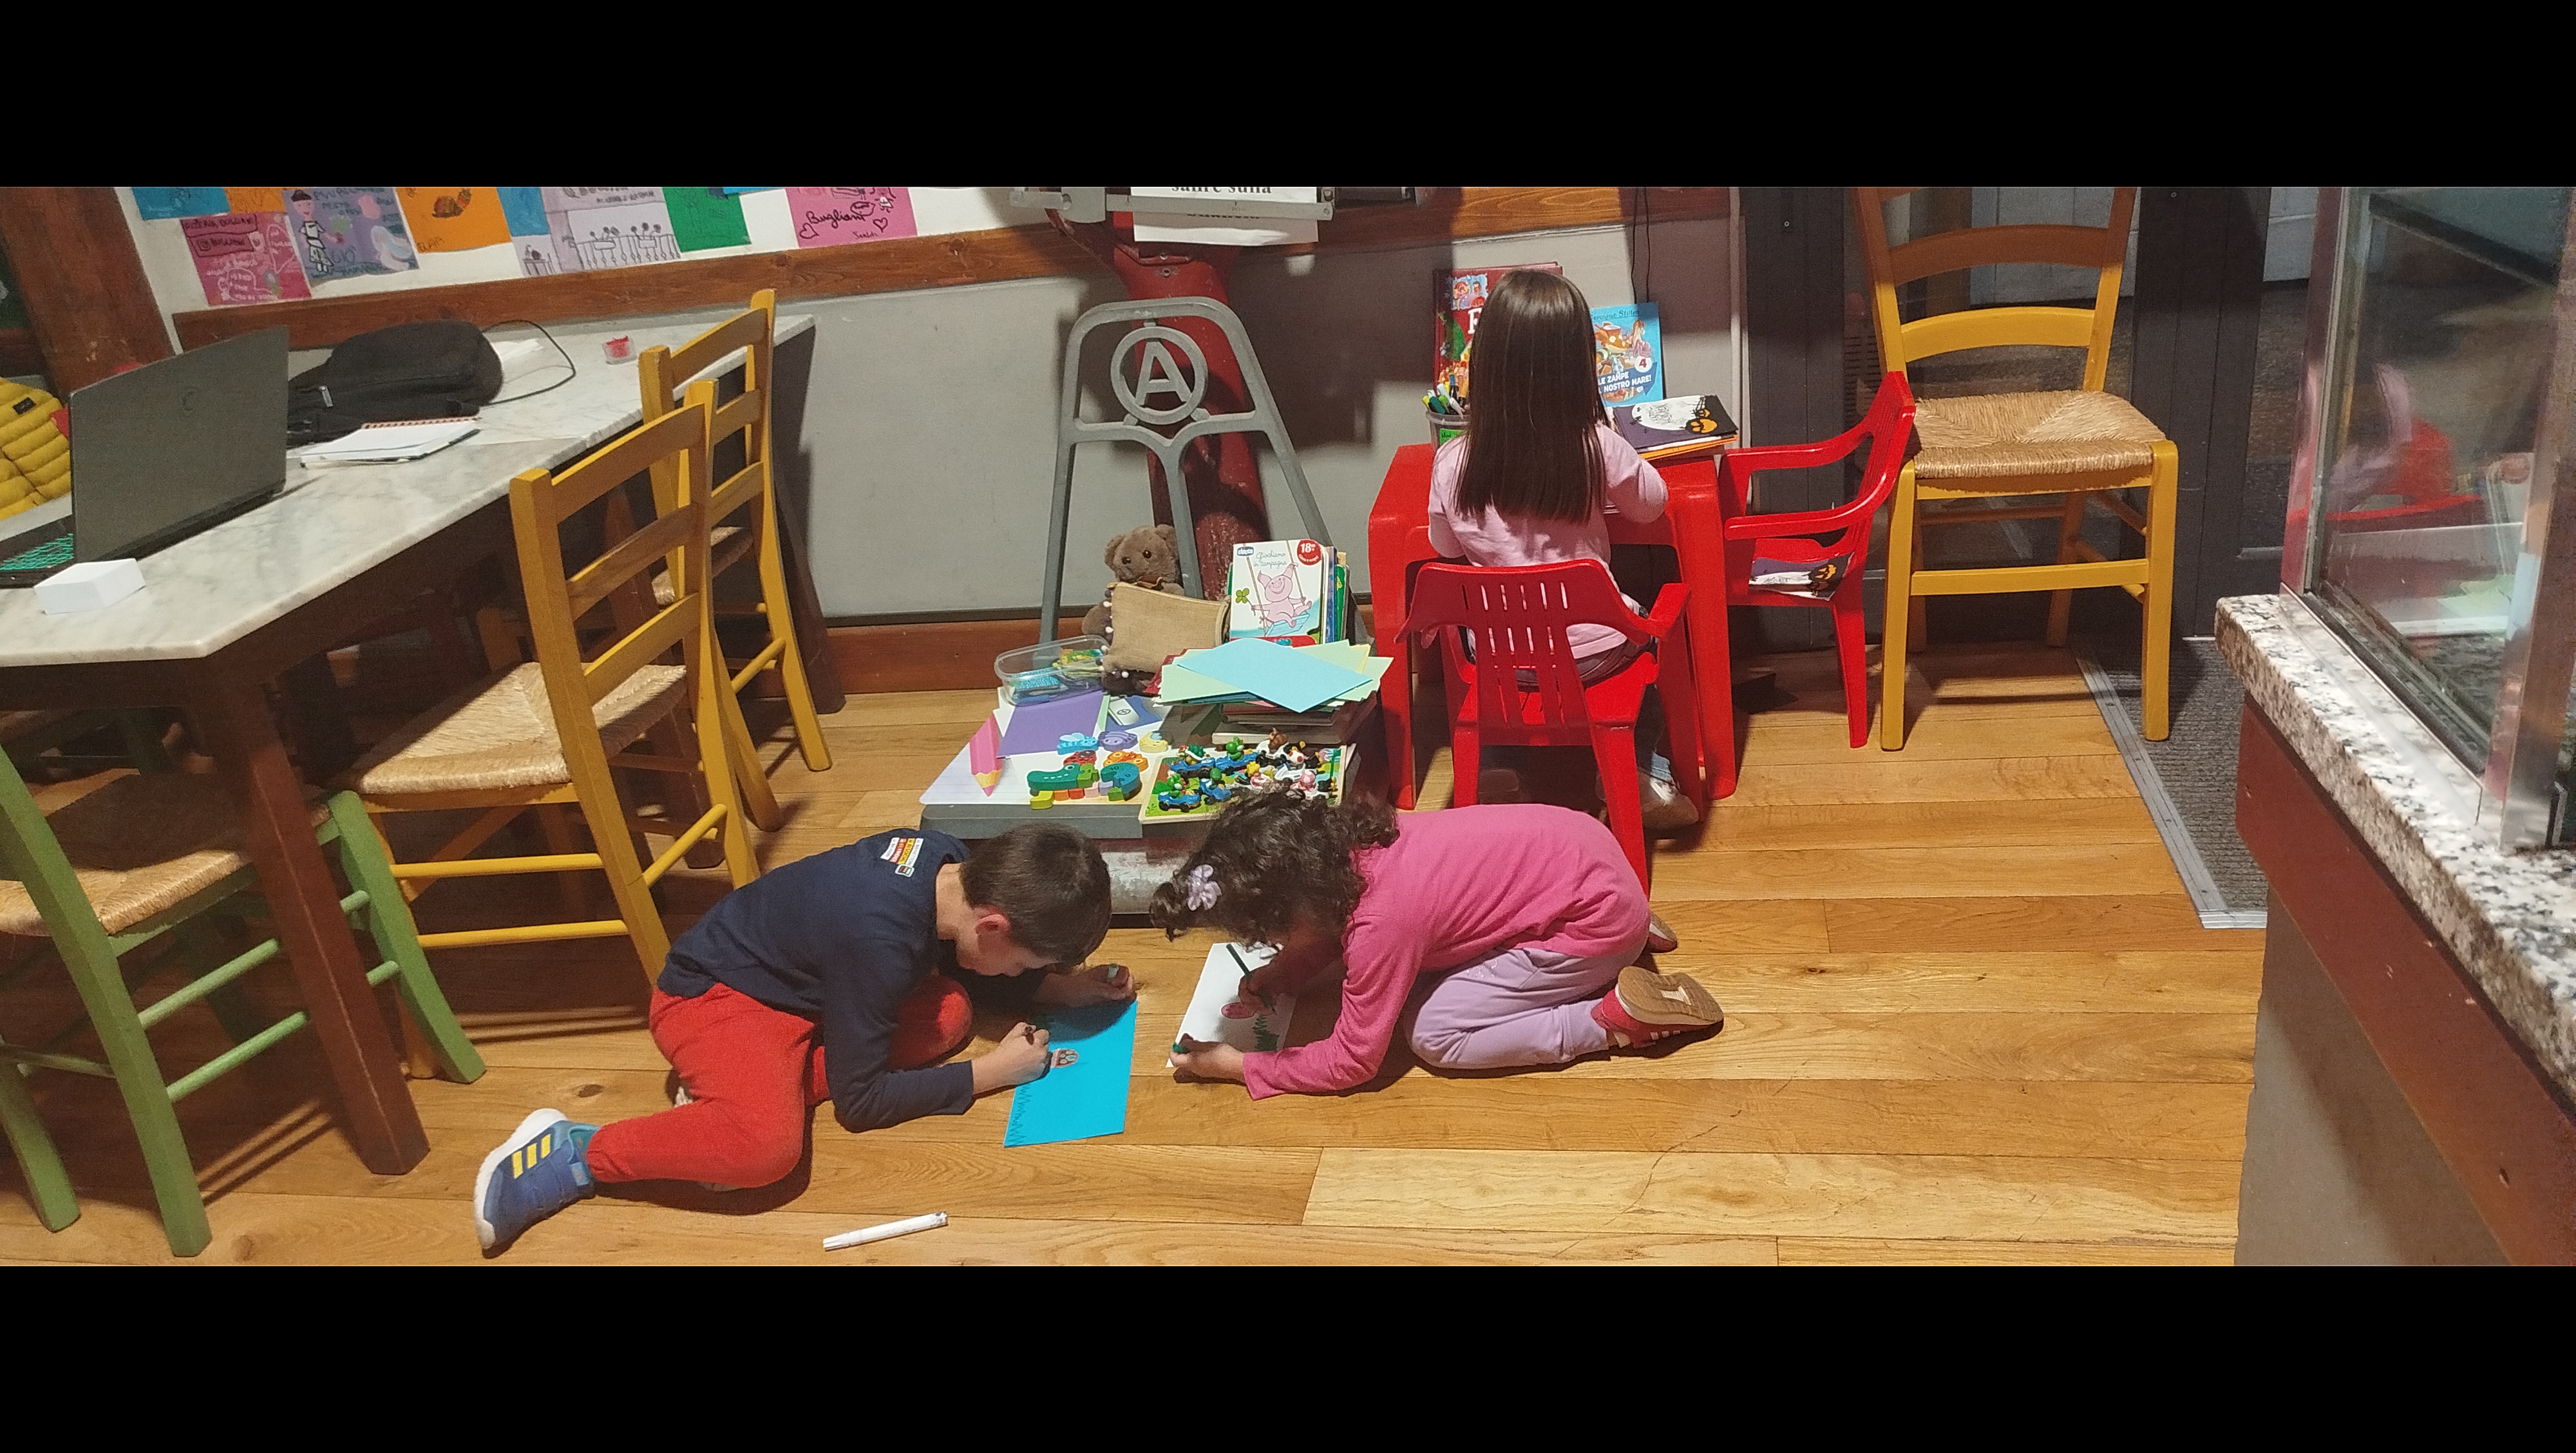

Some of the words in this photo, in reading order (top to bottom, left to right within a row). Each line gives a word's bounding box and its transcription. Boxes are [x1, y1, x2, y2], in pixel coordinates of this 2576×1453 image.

[1639, 358, 1647, 368] 4
[1604, 380, 1631, 392] NOSTRO
[1631, 374, 1652, 386] MARE!
[1607, 372, 1629, 383] ZAMPE
